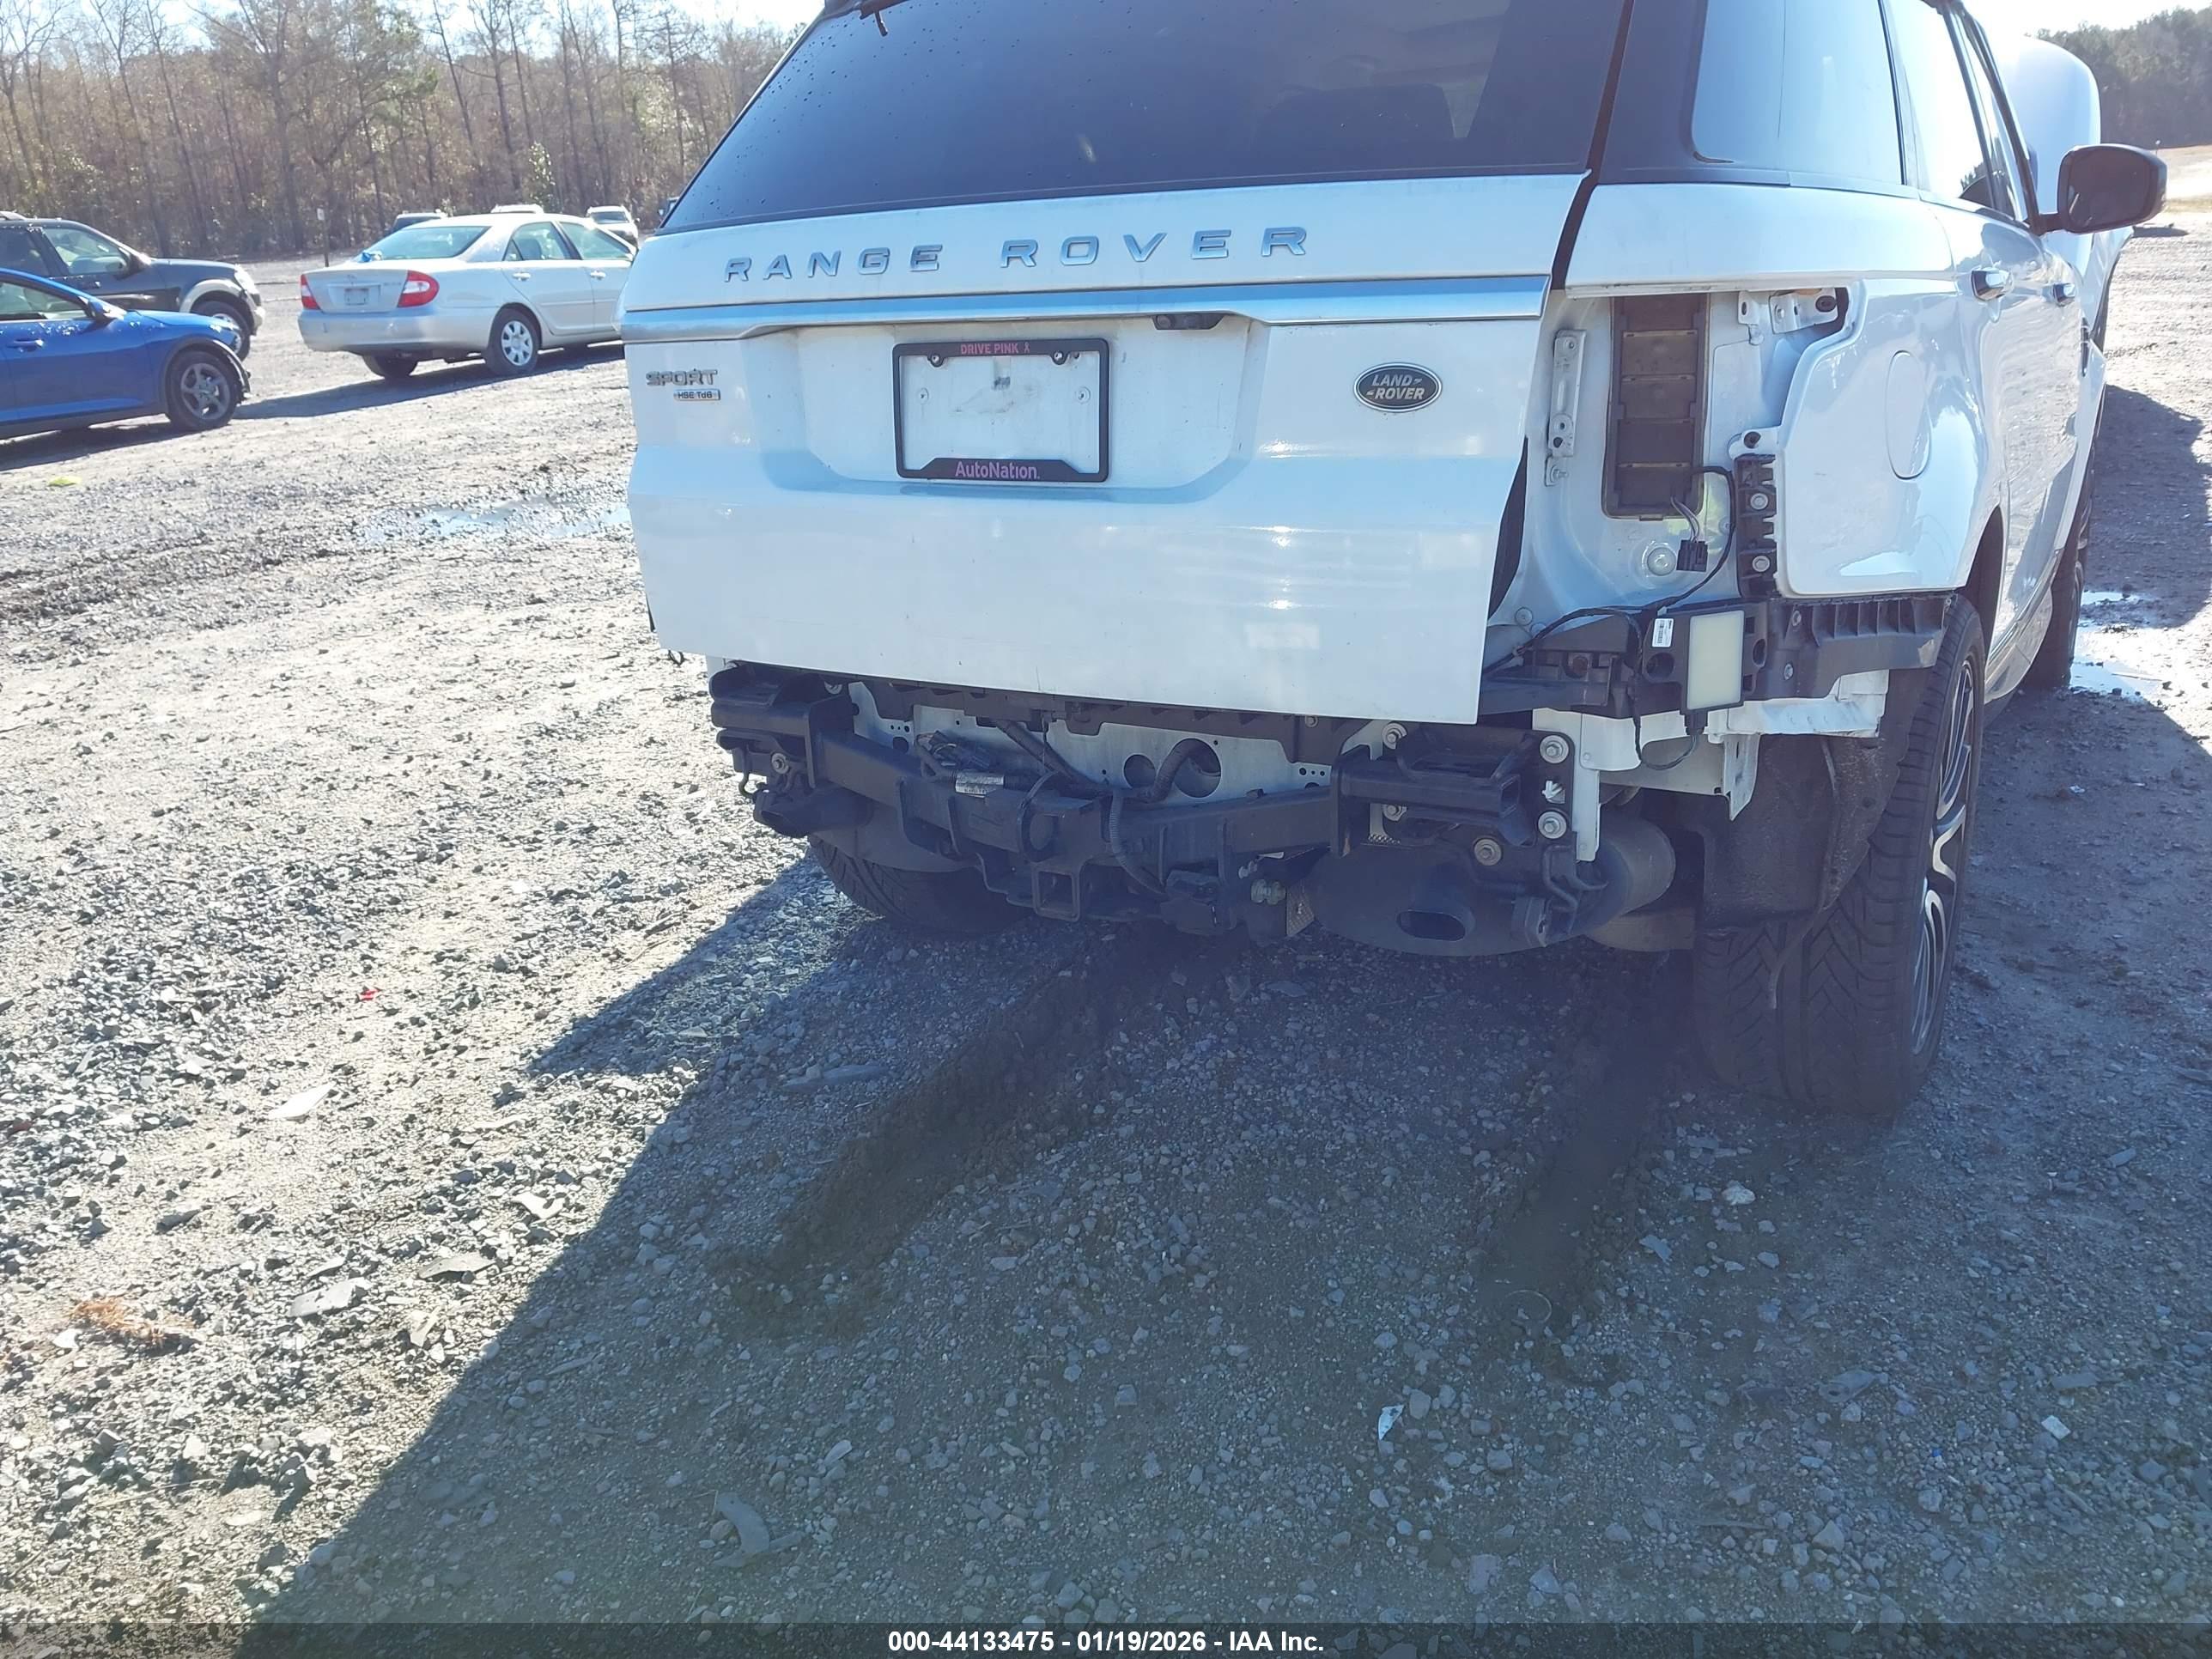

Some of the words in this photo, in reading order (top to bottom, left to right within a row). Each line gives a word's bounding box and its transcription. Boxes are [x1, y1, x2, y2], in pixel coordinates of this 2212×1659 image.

[724, 244, 944, 283] RANGE
[1000, 226, 1308, 268] ROVER
[960, 343, 992, 355] DRIVE
[994, 343, 1019, 354] PINK
[645, 368, 719, 386] SPORT
[1371, 374, 1413, 386] LAND
[677, 391, 695, 399] HSE
[696, 391, 713, 399] Td6
[1374, 387, 1425, 400] ROVER
